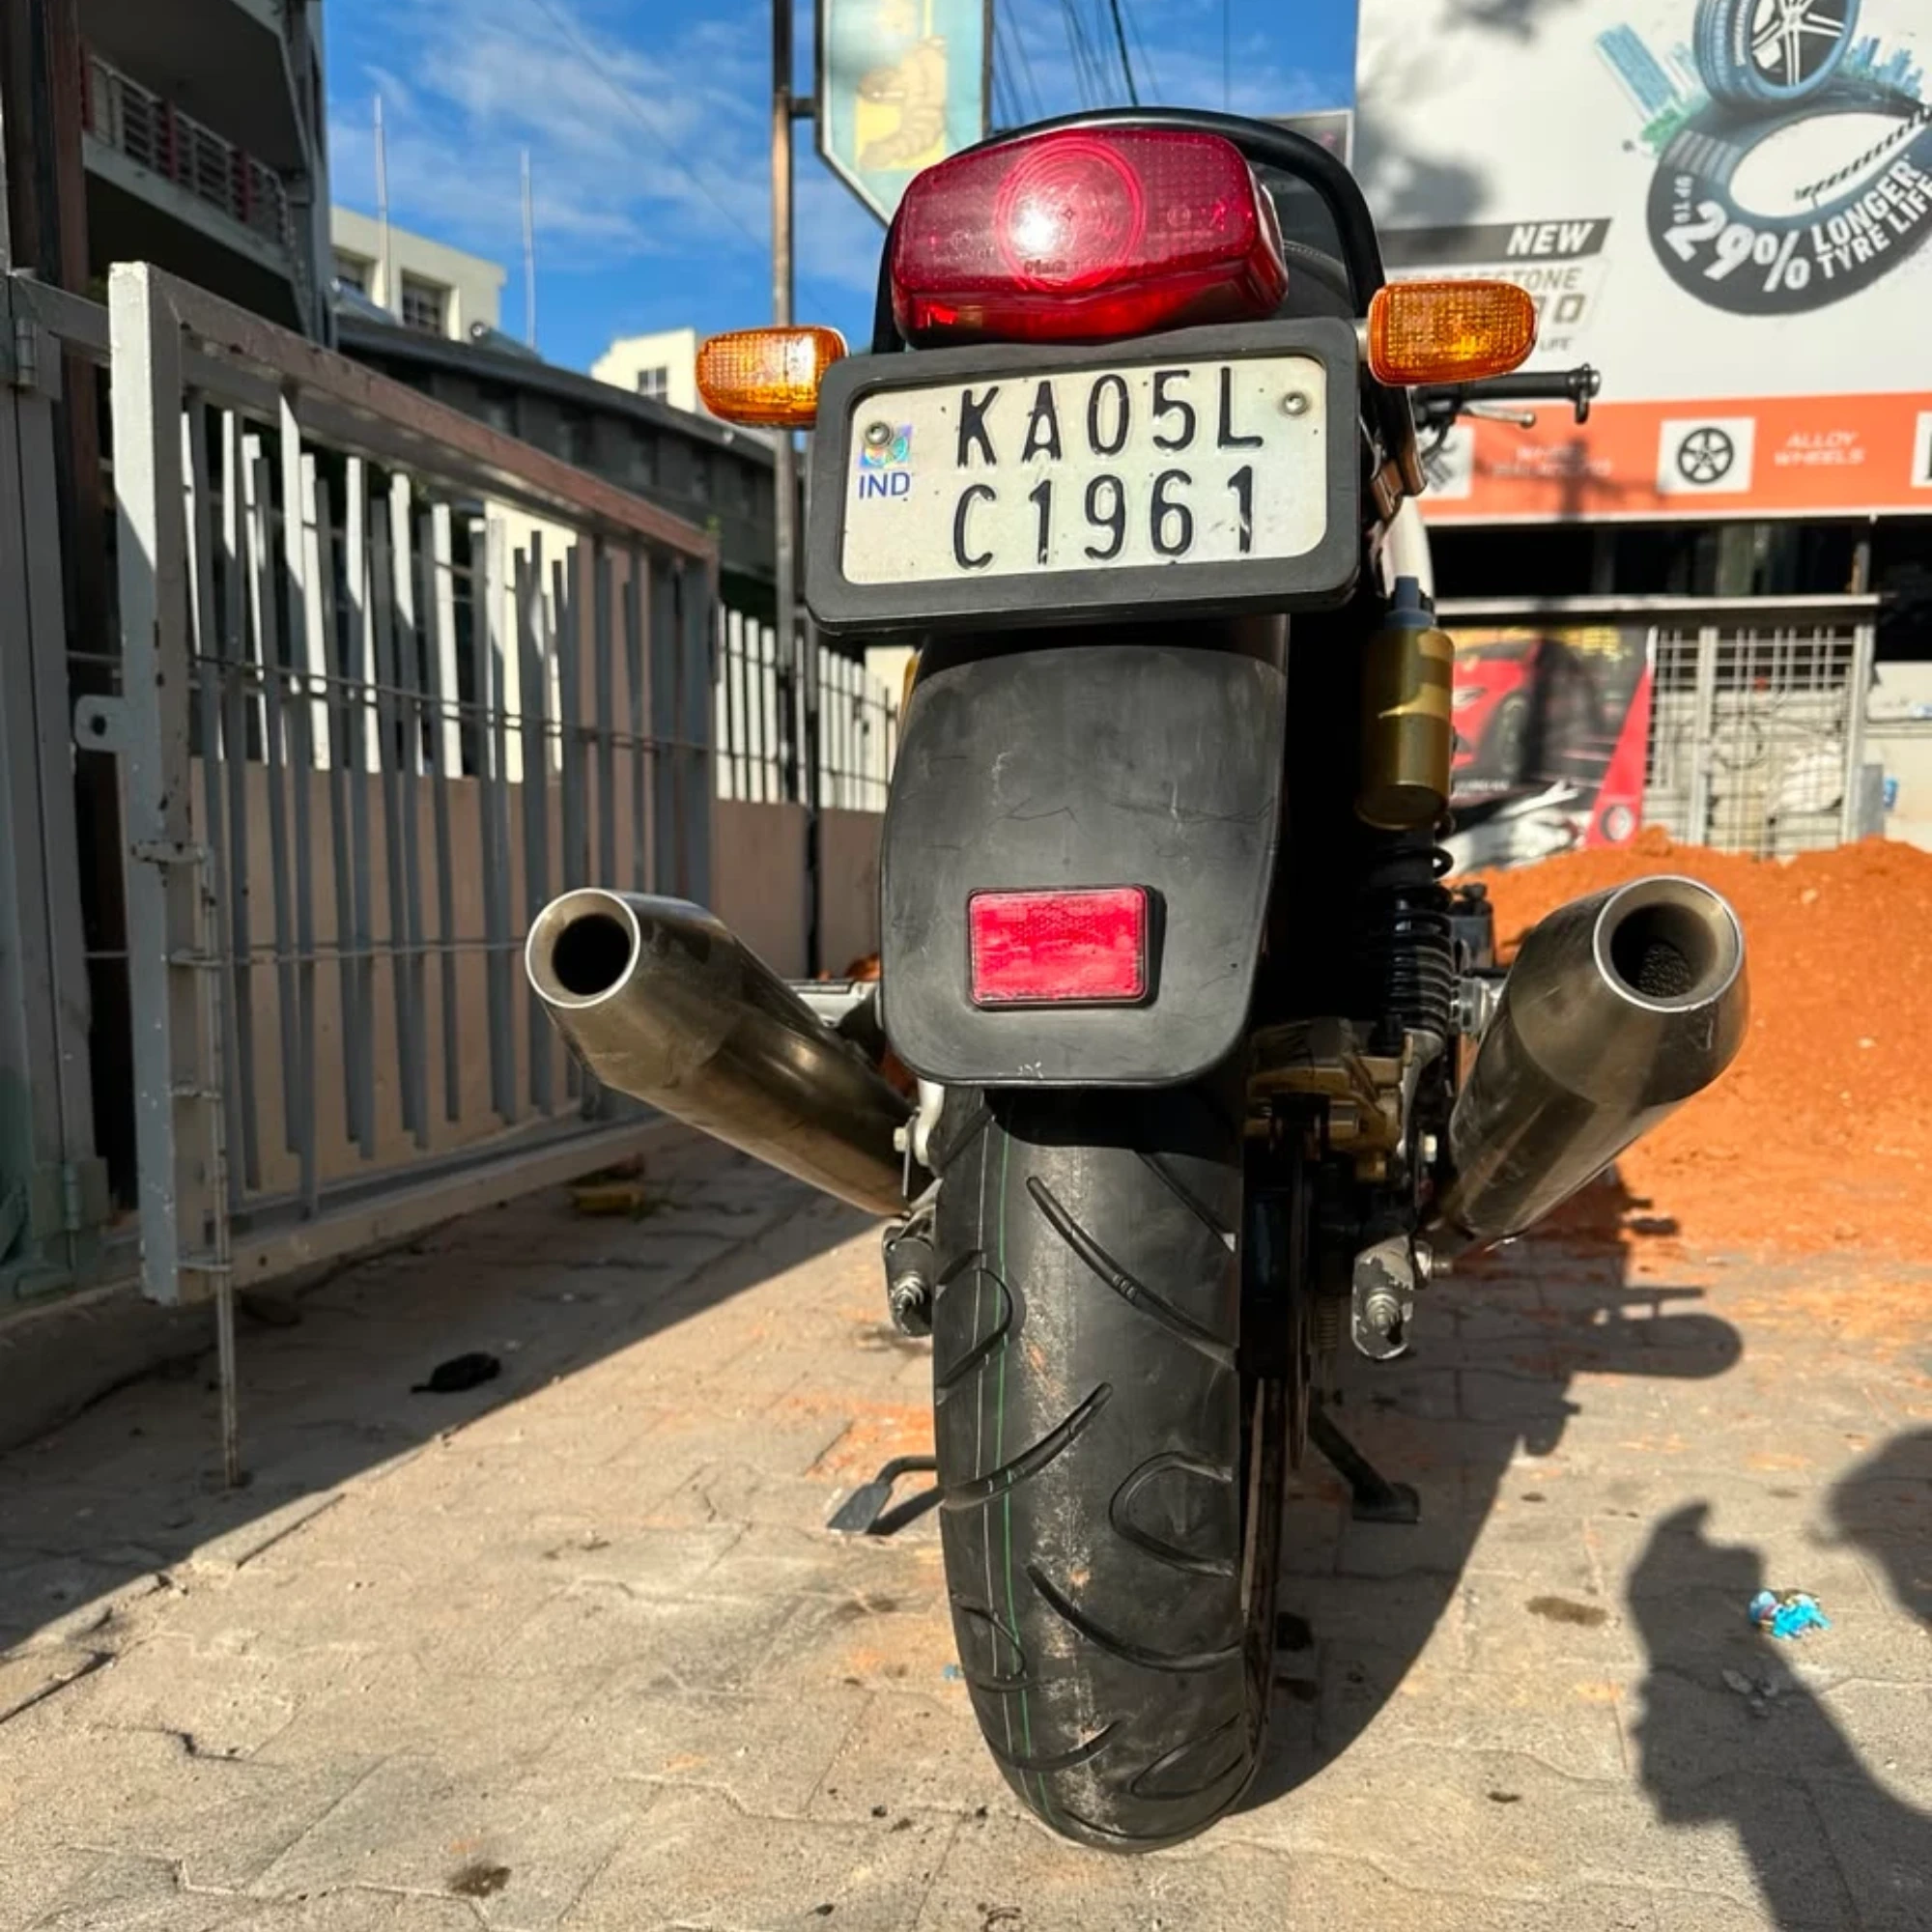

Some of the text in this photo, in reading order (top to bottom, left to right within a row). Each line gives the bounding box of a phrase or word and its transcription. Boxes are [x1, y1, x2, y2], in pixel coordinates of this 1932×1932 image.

[1507, 222, 1594, 256] NEW
[1662, 201, 1810, 292] 29%
[1817, 174, 1932, 279] TYRE LIFE
[956, 366, 1264, 468] KA05L
[1786, 431, 1860, 447] ALLOY
[859, 471, 911, 498] IND
[1775, 447, 1864, 466] WHEELS
[952, 465, 1254, 570] C1961
